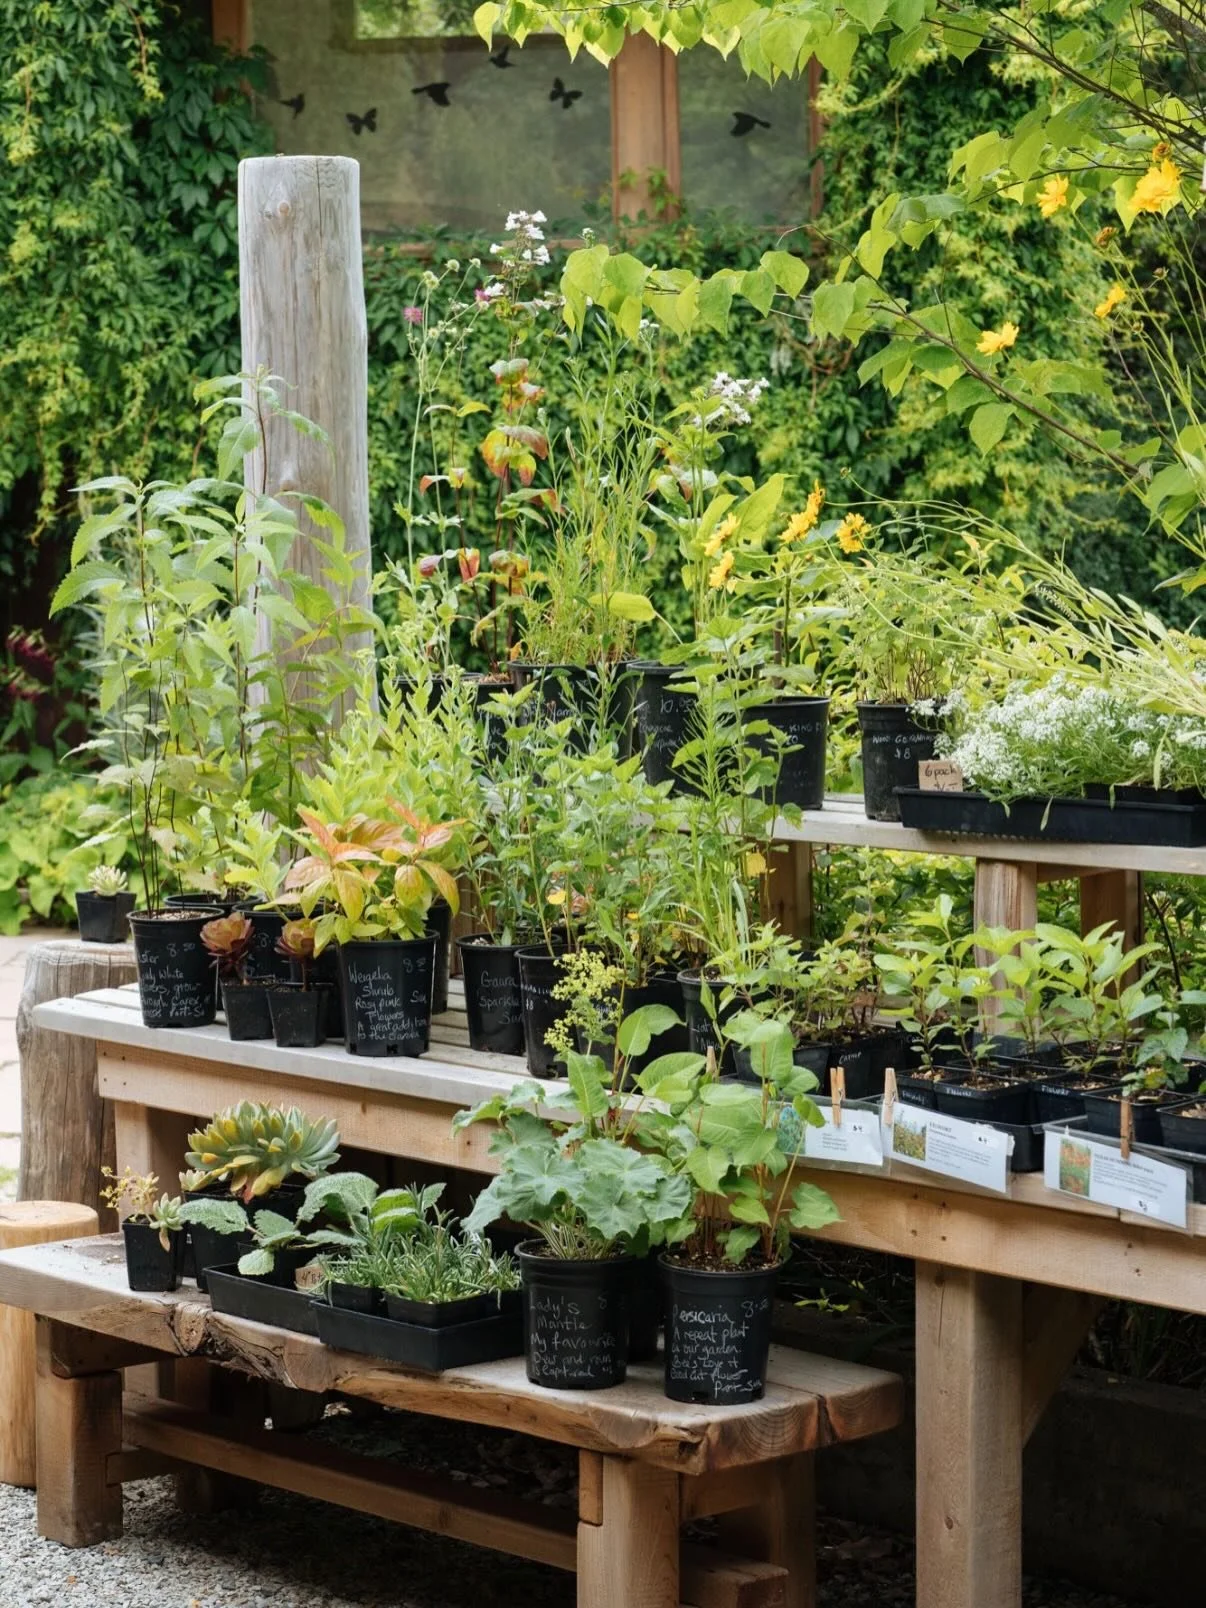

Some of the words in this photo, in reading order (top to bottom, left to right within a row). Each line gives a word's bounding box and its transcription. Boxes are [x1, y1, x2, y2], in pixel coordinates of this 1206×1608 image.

[480, 970, 519, 988] Gaura
[671, 1303, 736, 1328] Persicaria
[530, 1332, 547, 1353] My
